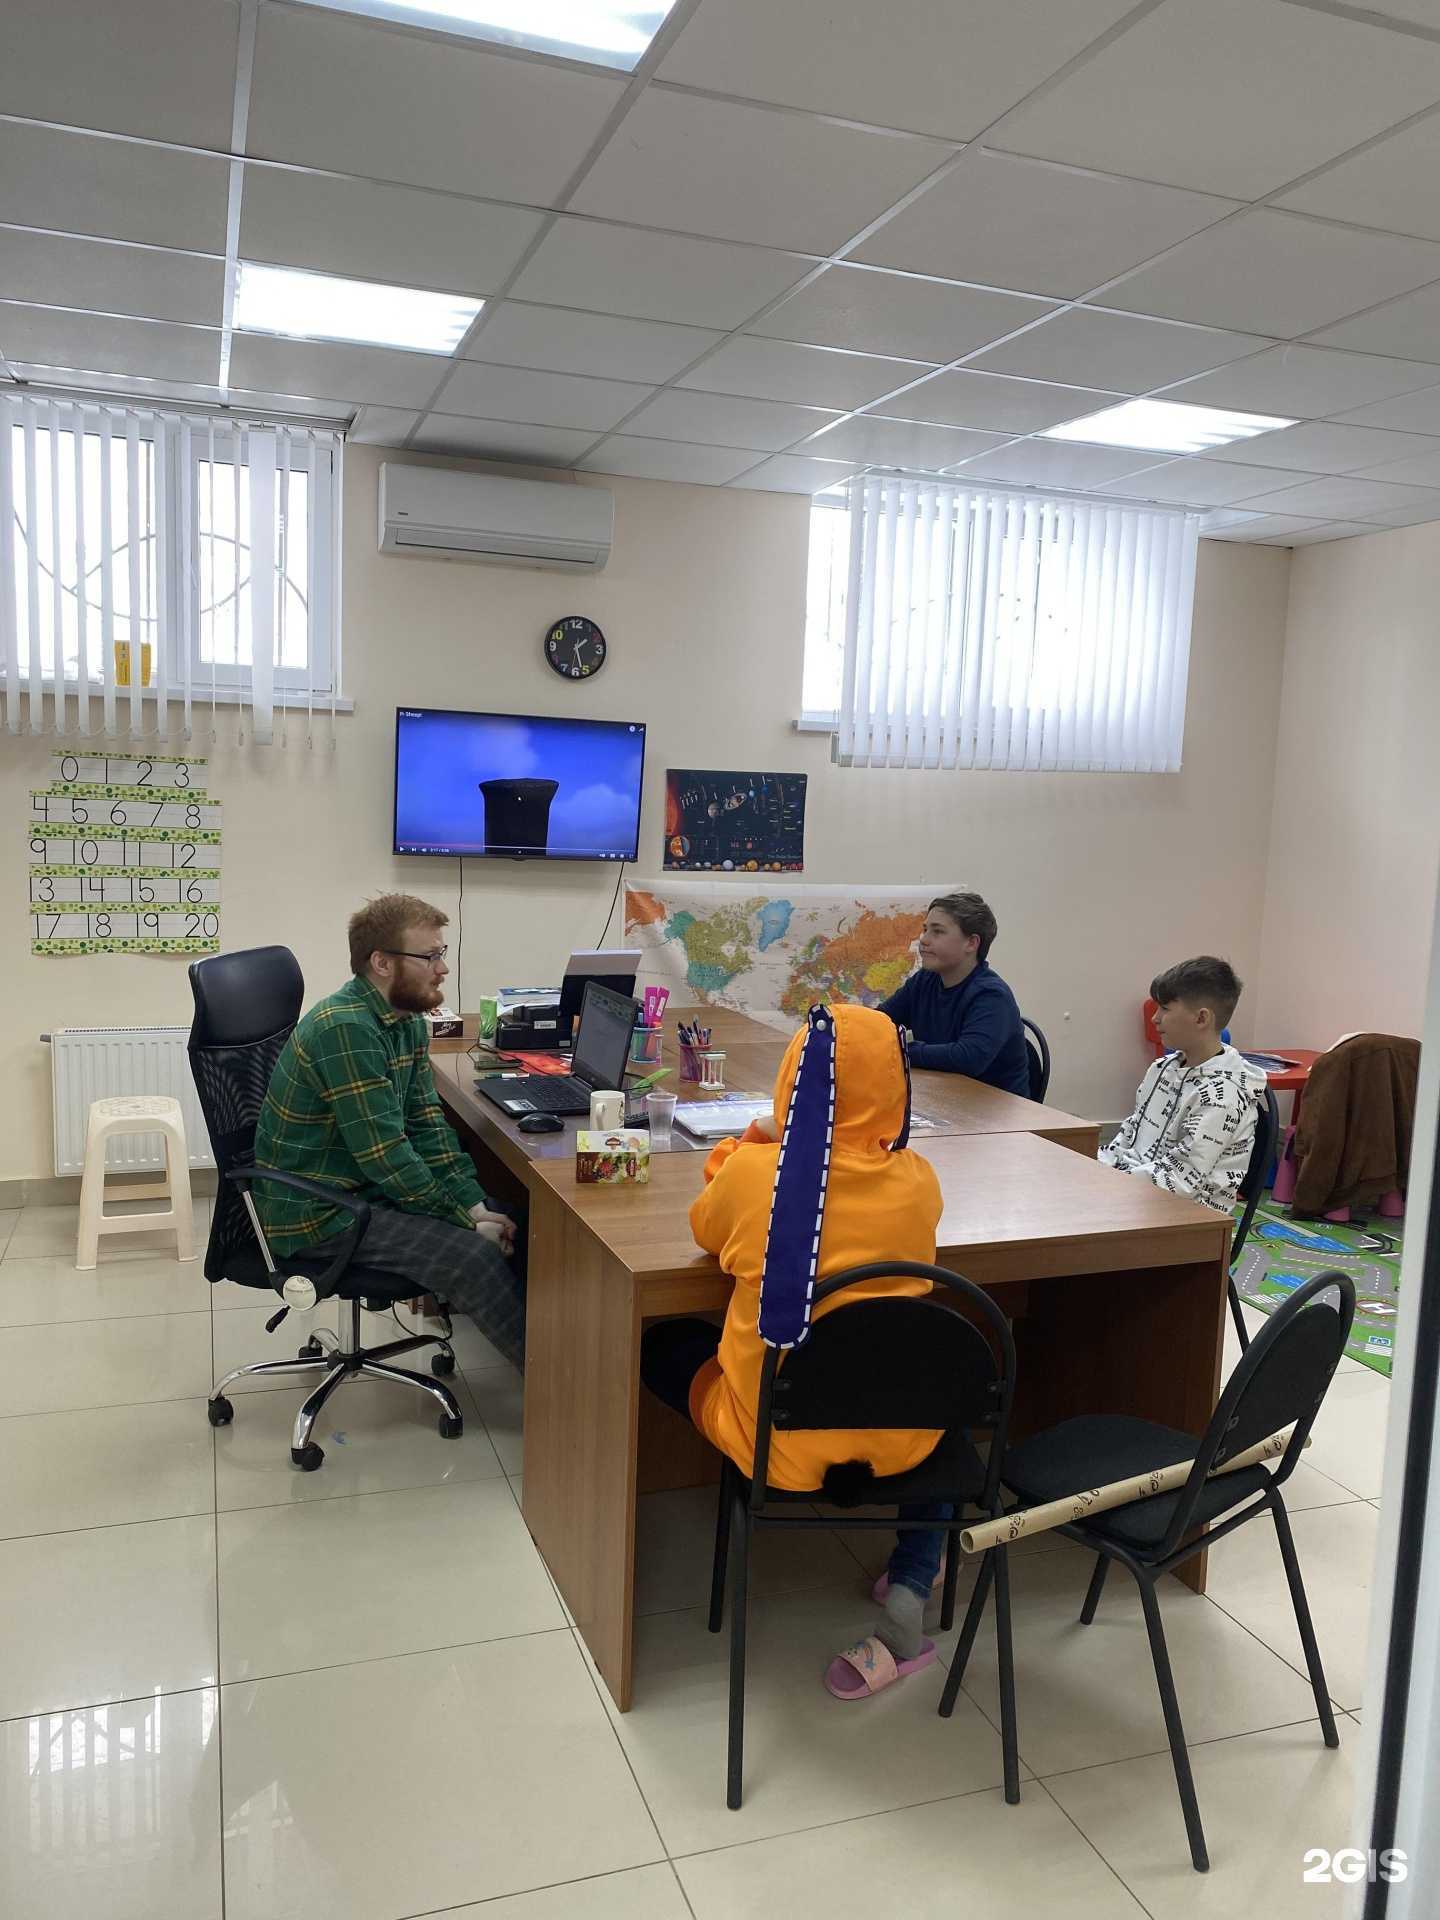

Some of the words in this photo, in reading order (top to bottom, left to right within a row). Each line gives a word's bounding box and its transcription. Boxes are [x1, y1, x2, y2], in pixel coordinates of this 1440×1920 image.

[569, 620, 583, 629] 12
[550, 641, 557, 651] 9
[595, 645, 603, 654] 3
[560, 664, 568, 672] 7
[572, 667, 579, 676] 6
[582, 665, 590, 674] 5
[61, 756, 78, 782] 0
[137, 761, 152, 786] 2
[174, 763, 189, 788] 3
[33, 796, 49, 822] 4
[72, 798, 88, 824] 5
[110, 801, 126, 825] 6
[149, 802, 163, 827] 7
[185, 804, 200, 829] 8
[30, 838, 46, 864] 9
[172, 843, 196, 868] 12
[30, 877, 54, 902] 13
[81, 877, 104, 902] 14
[130, 878, 154, 902] 15
[179, 878, 202, 903] 16
[37, 913, 61, 939] 17
[87, 913, 111, 938] 18
[137, 913, 159, 938] 19
[185, 913, 219, 938] 20
